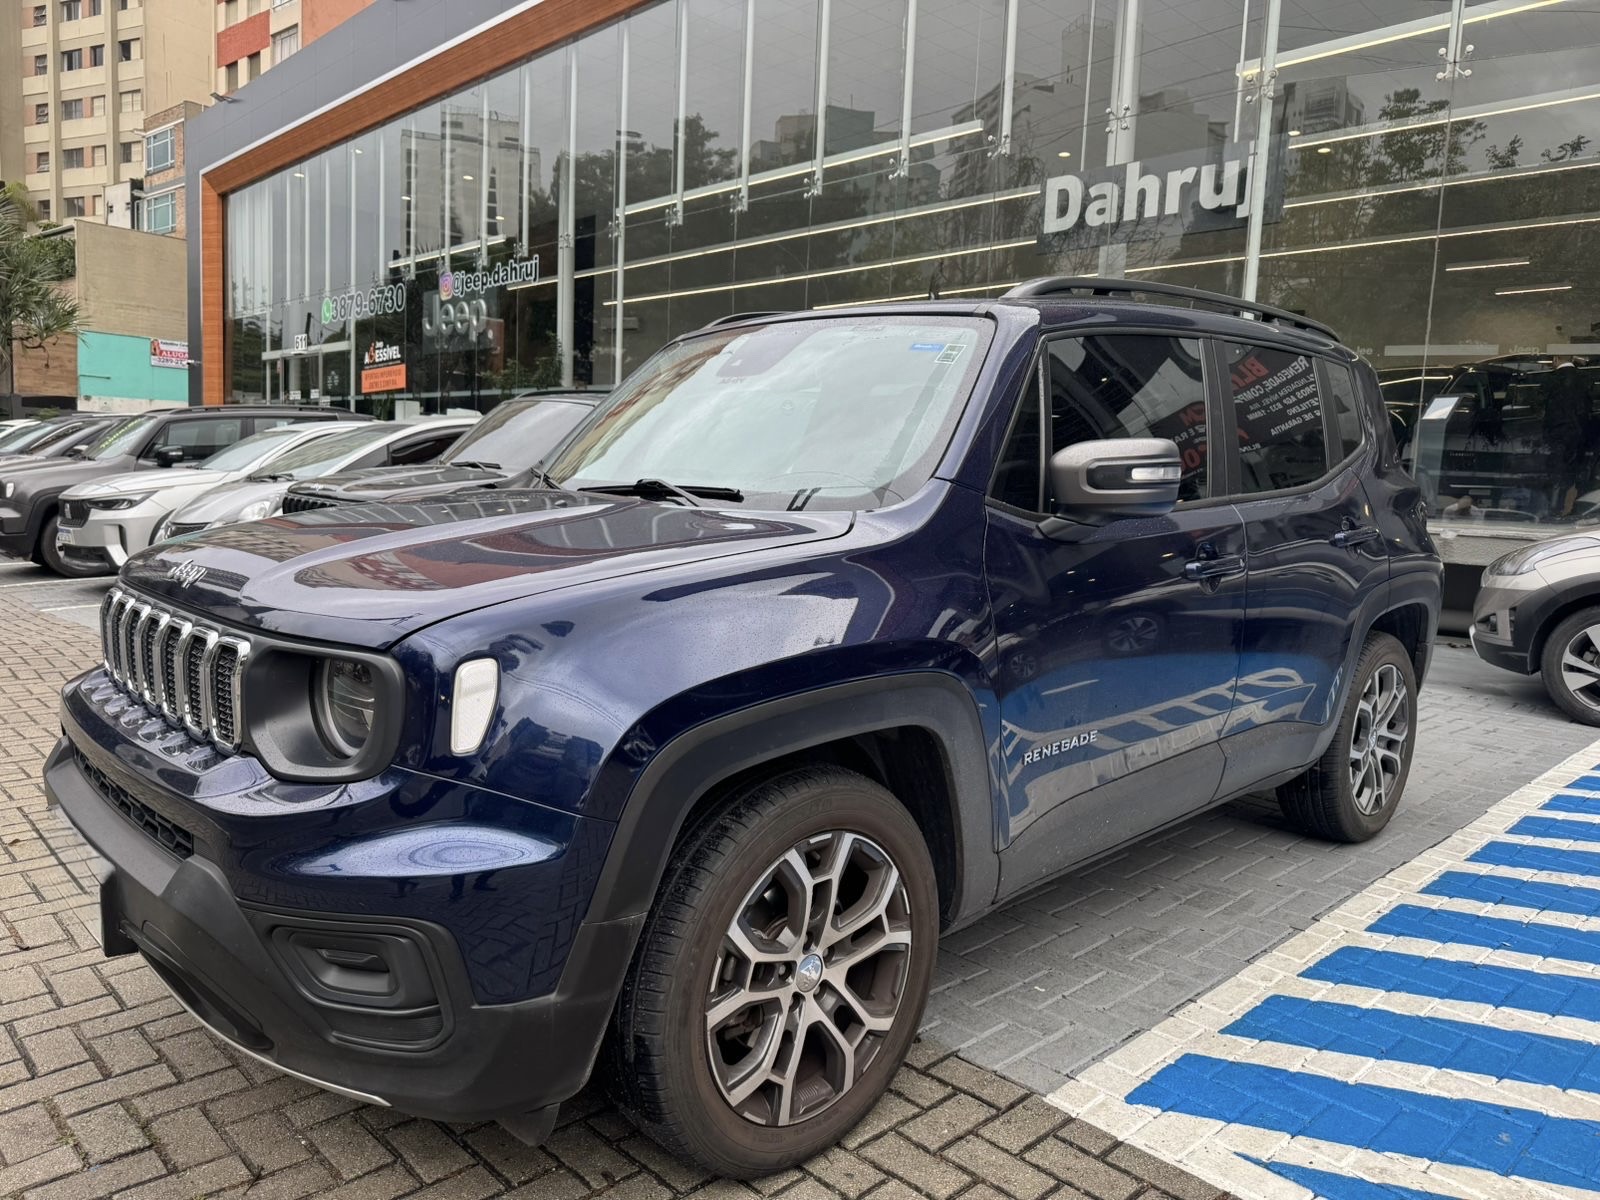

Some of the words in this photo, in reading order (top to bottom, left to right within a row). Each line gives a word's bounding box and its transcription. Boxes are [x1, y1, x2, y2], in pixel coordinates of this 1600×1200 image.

[1043, 154, 1254, 234] Dahruj
[452, 254, 539, 297] @jeep.dahruj
[332, 283, 405, 321] 3879-6730
[422, 294, 487, 342] Jeep
[296, 336, 307, 349] 611
[167, 559, 208, 589] Jeep
[1023, 730, 1099, 766] RENEGADE
